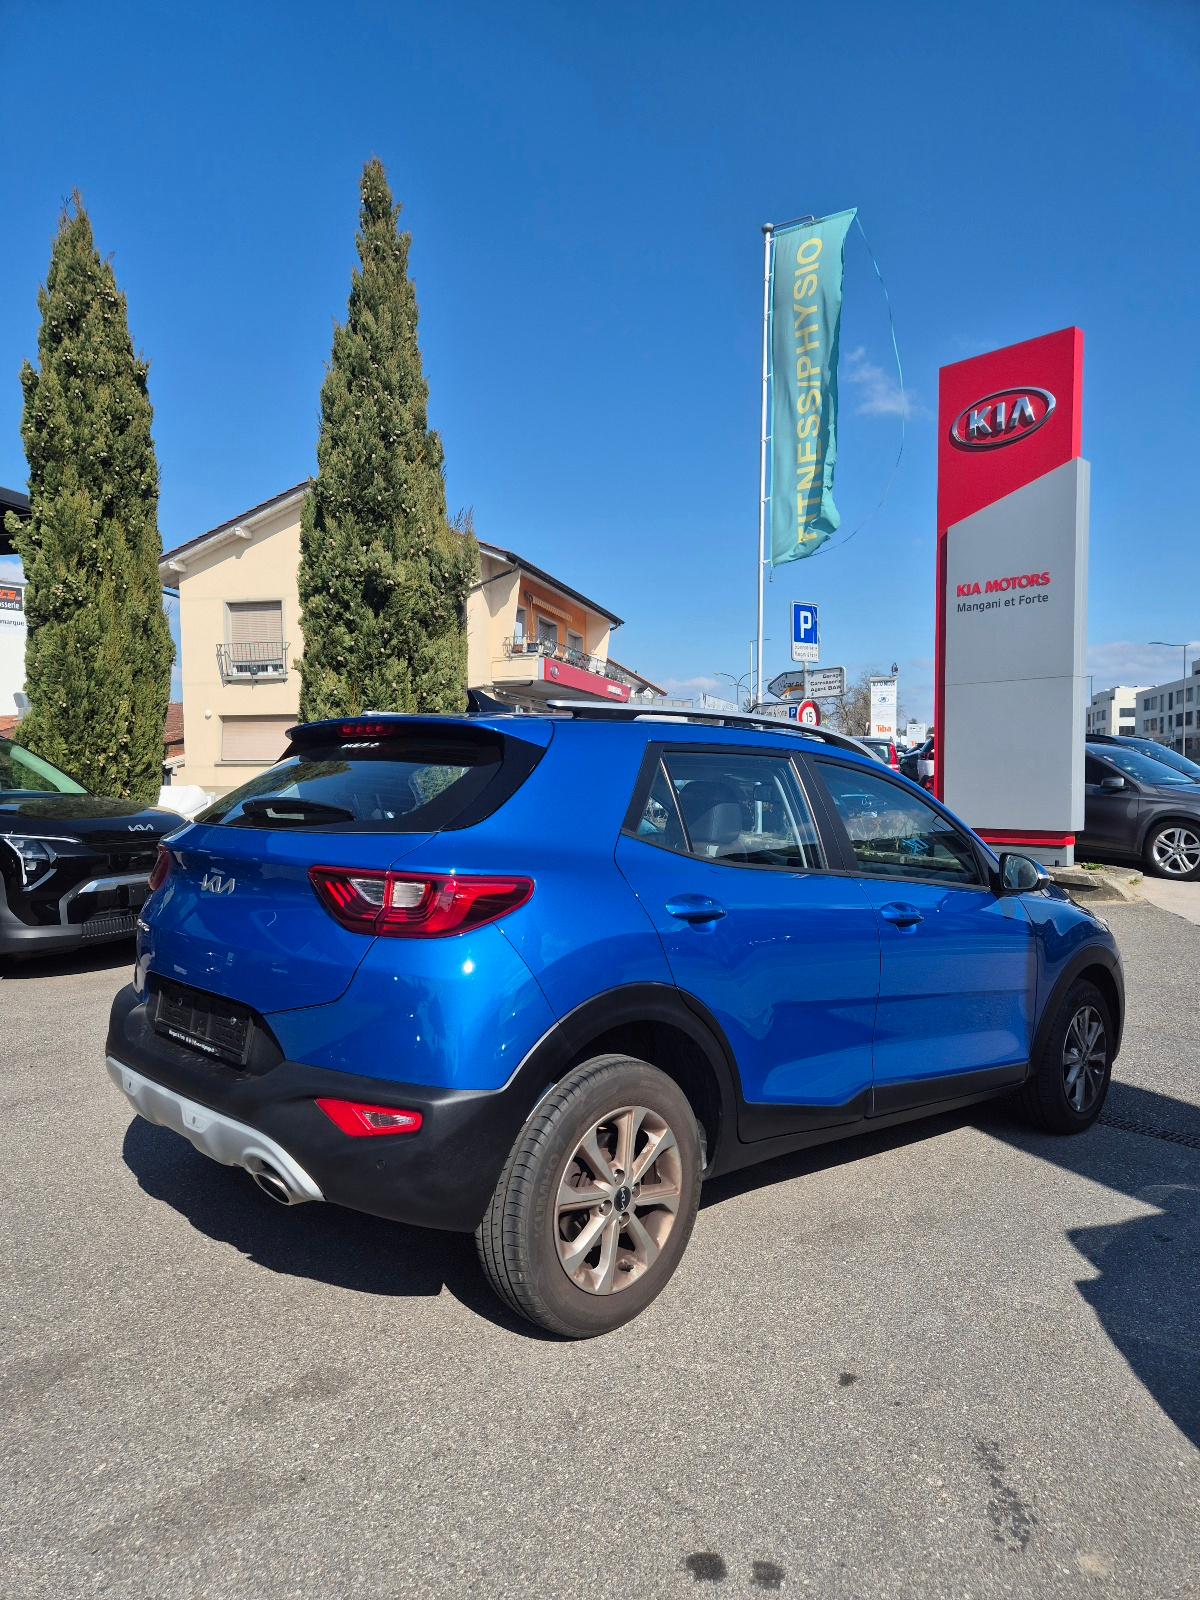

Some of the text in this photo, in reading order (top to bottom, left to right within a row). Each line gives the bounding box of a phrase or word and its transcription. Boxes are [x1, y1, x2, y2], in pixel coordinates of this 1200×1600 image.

[968, 396, 1036, 438] KIA
[956, 572, 1052, 598] KIA MOTORS
[0, 601, 20, 609] sserie
[957, 594, 1049, 613] Mangani et Forte
[800, 610, 812, 638] P
[790, 708, 796, 717] P
[805, 711, 813, 722] 15
[200, 873, 236, 895] KIA
